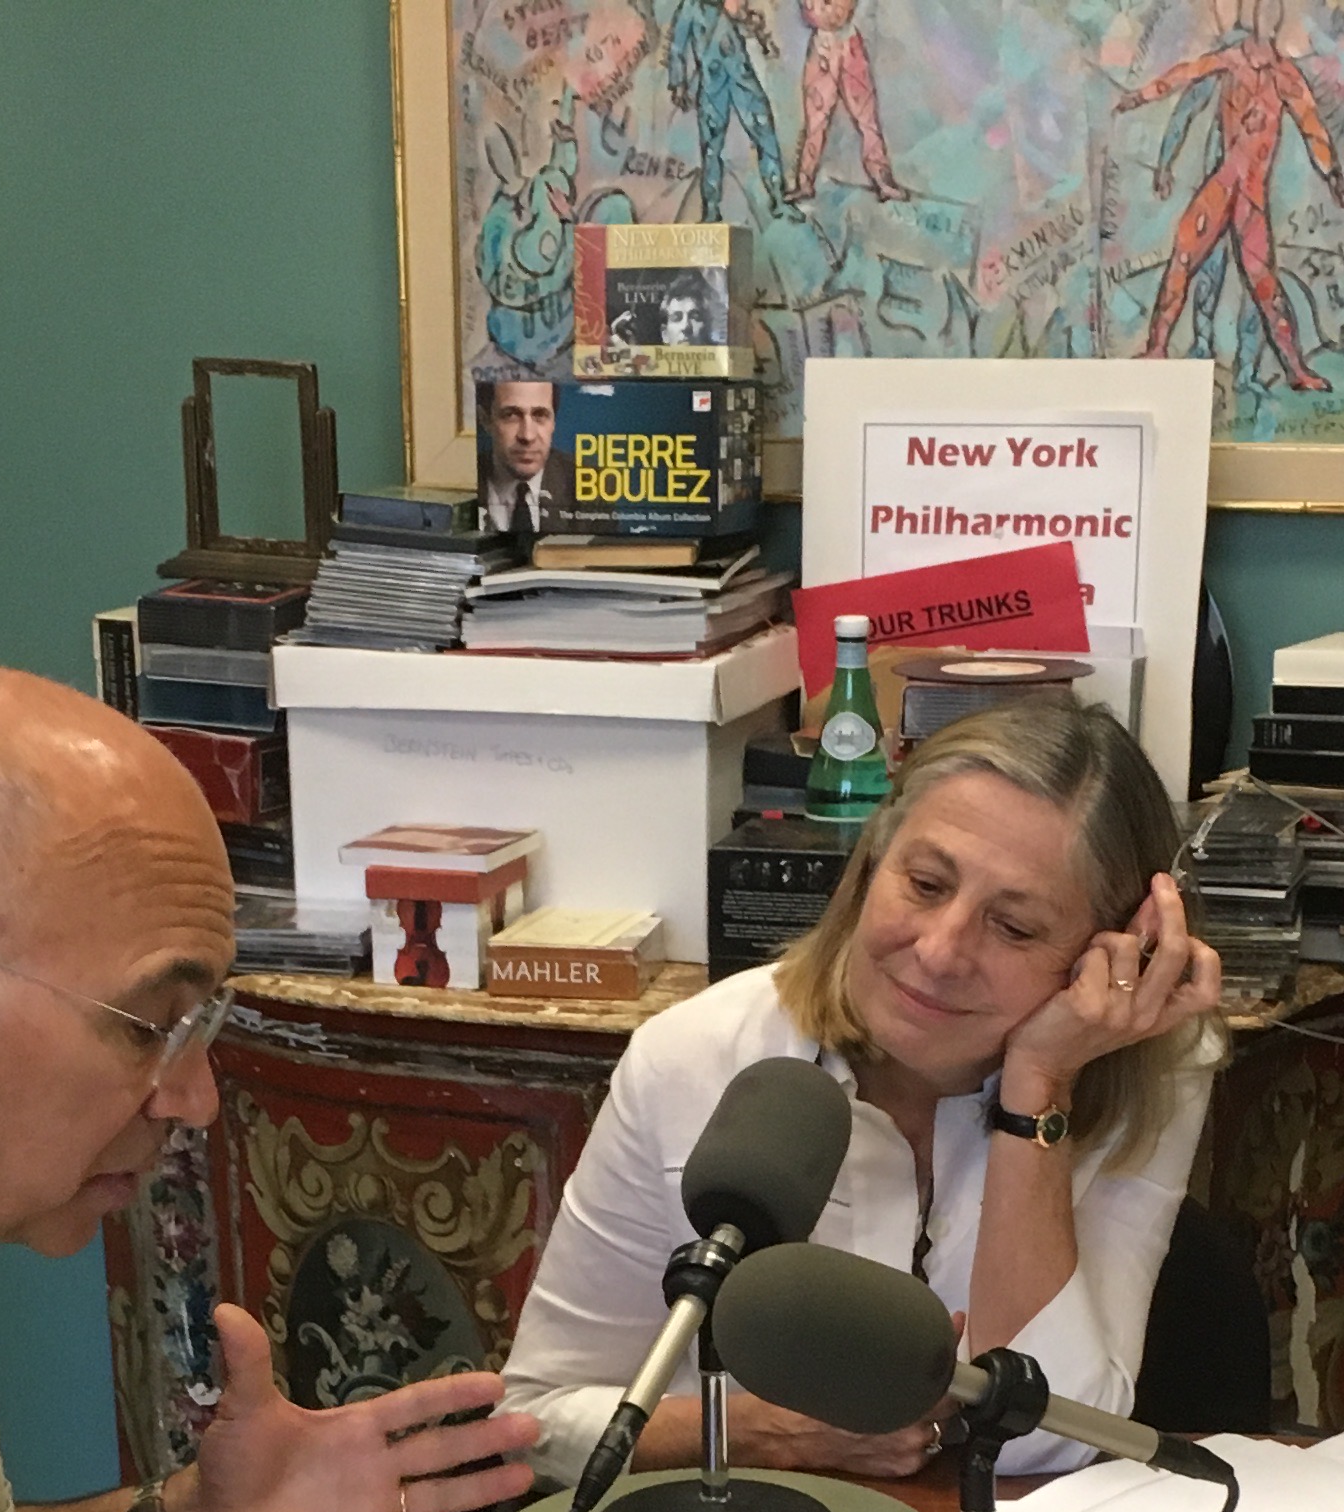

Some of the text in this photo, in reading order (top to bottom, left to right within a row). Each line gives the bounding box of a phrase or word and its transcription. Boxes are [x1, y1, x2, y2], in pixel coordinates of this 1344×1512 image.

[614, 228, 721, 247] NEW YORK
[625, 292, 656, 303] LIVE
[655, 349, 715, 363] Bernstein
[668, 362, 702, 375] LIVE
[576, 434, 697, 468] PIERRE
[906, 437, 1100, 468] New York
[576, 469, 711, 503] BOULEZ
[870, 506, 1133, 539] Philharmonic
[868, 590, 1032, 641] OUR TRUNKS
[492, 960, 603, 984] MAHLER
